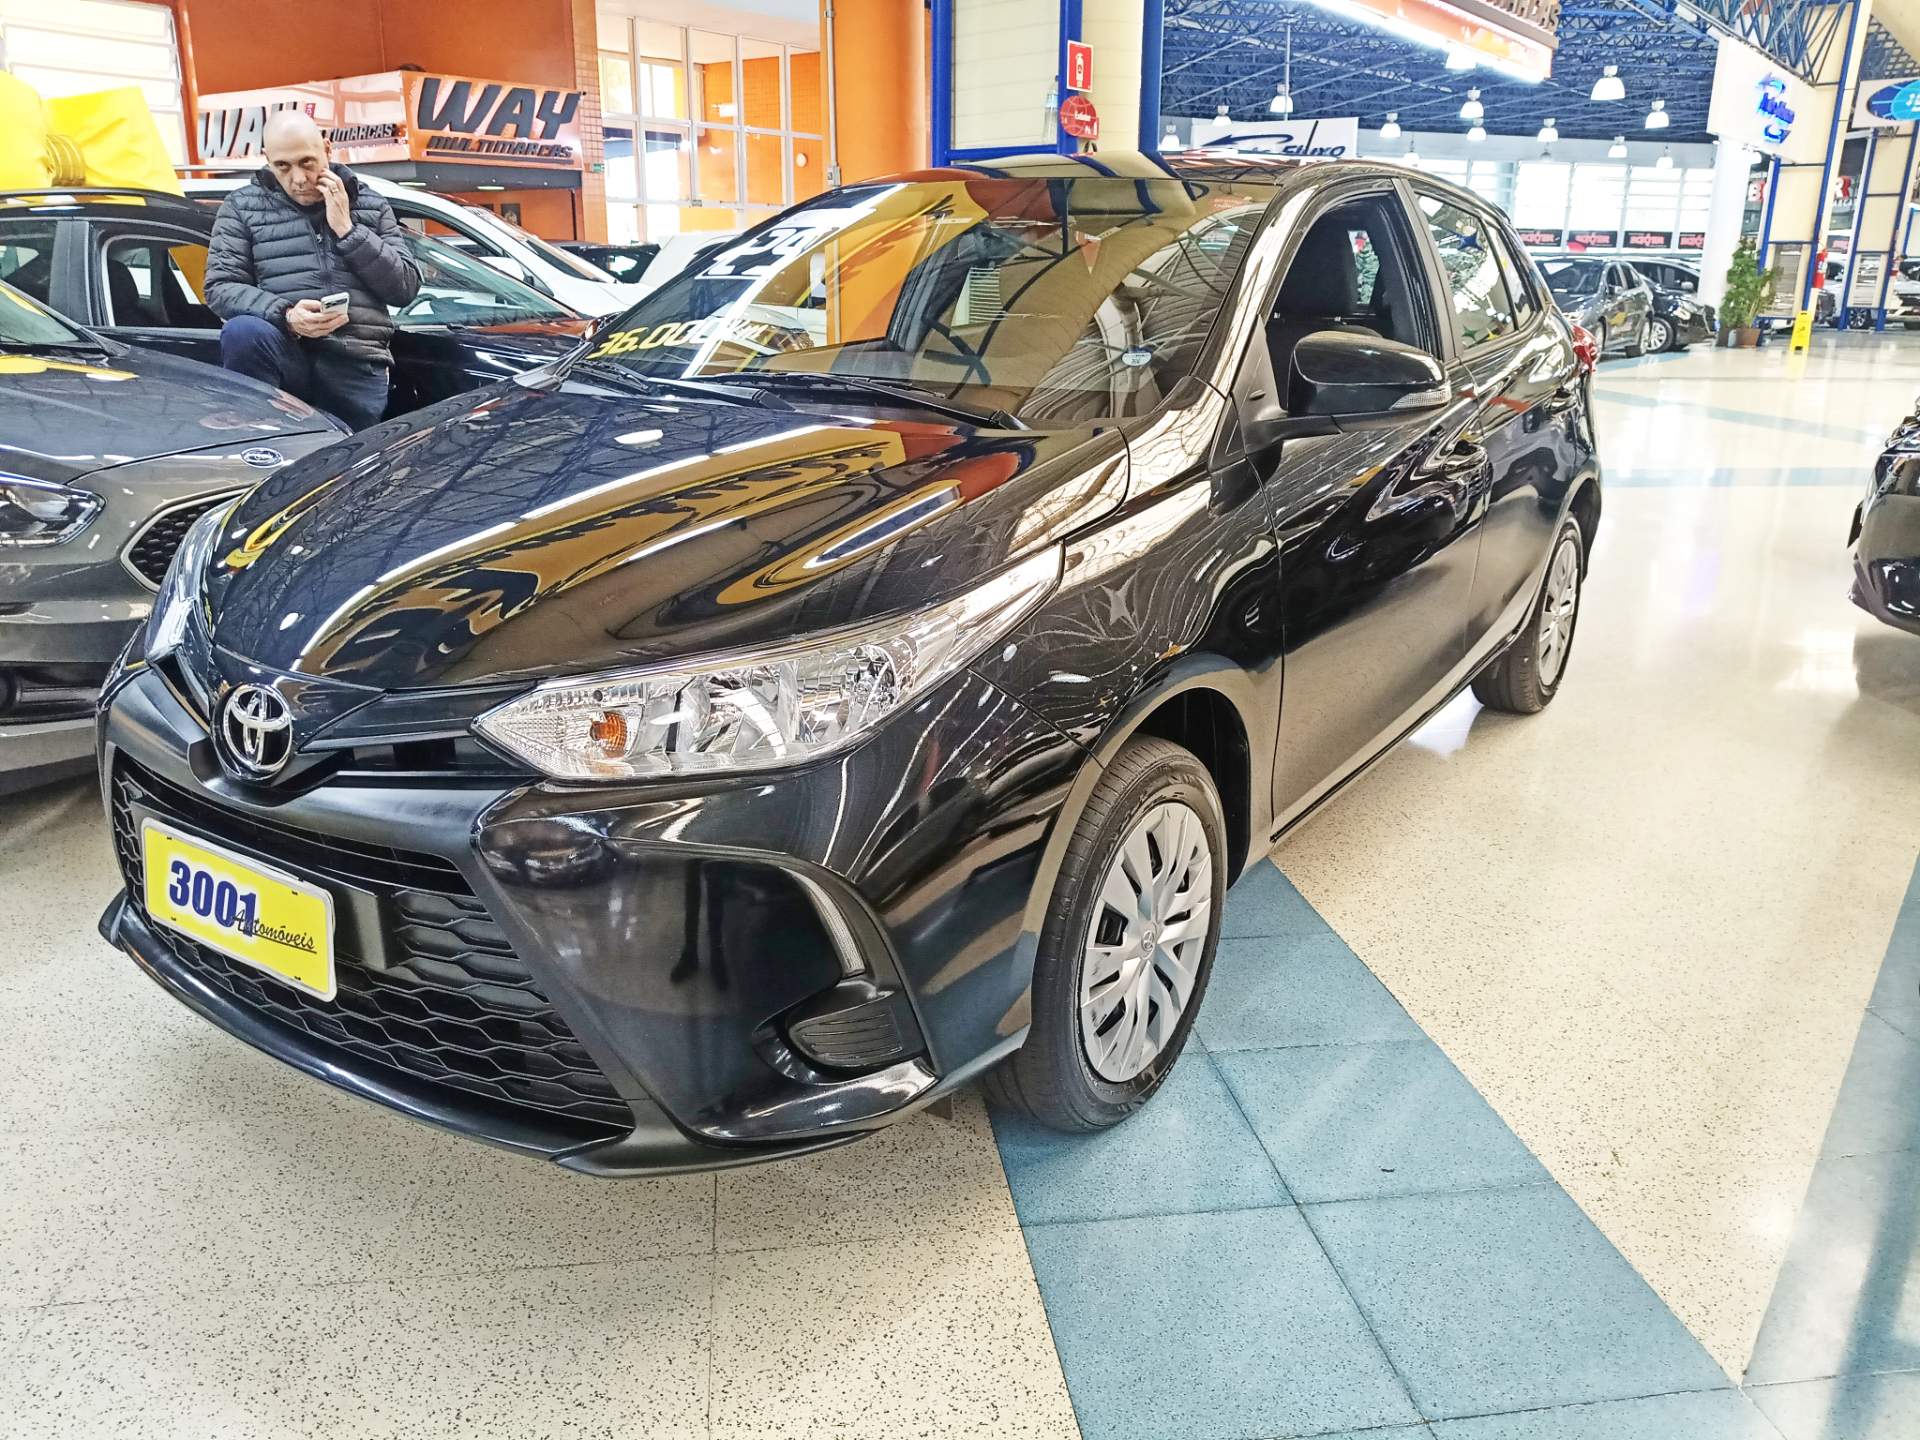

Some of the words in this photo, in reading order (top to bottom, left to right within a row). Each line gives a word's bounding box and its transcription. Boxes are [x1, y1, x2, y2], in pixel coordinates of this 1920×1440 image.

[199, 101, 297, 157] WA
[418, 77, 581, 140] WAY
[169, 860, 257, 938] 3001
